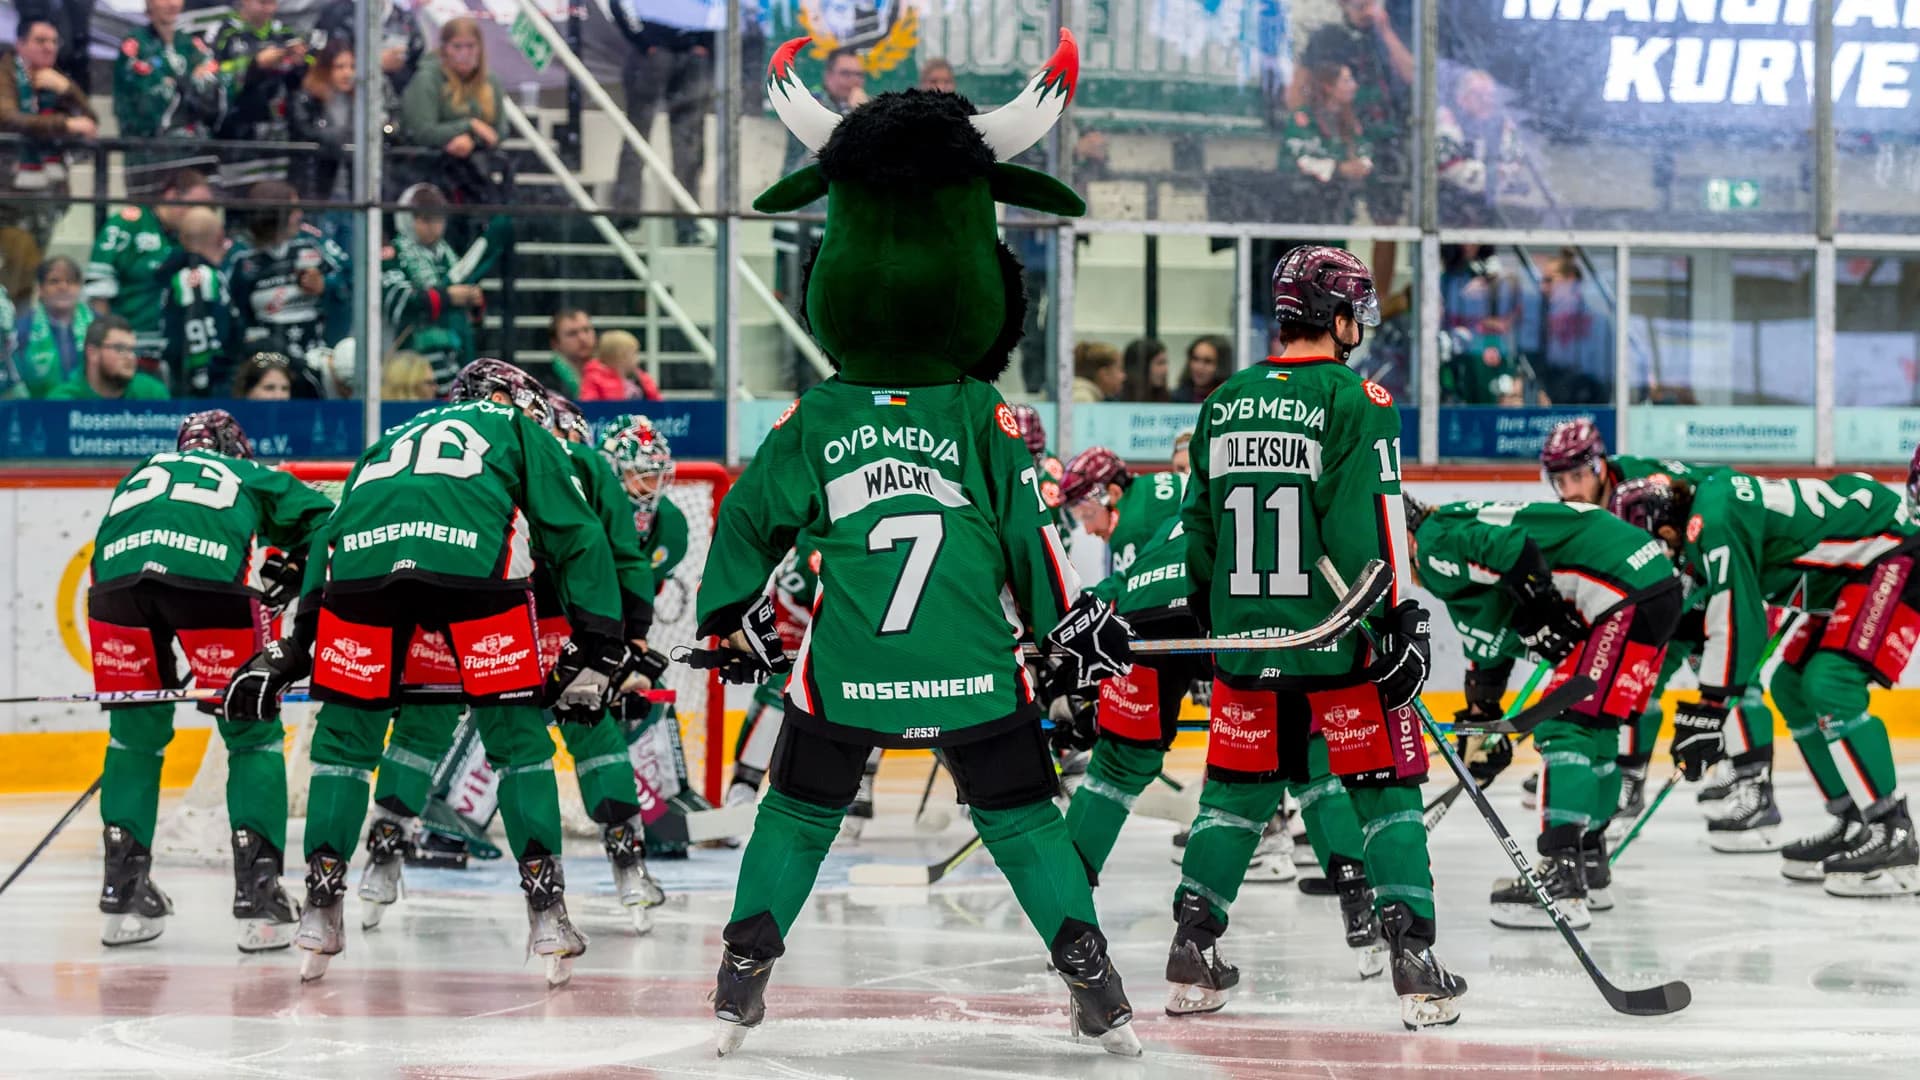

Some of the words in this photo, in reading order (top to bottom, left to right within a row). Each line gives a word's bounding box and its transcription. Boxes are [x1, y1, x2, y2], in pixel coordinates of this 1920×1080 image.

[1603, 36, 1919, 108] KURVE
[1211, 397, 1254, 426] OVB
[1258, 396, 1326, 431] MEDIA
[824, 425, 878, 464] OVB
[882, 426, 960, 466] MEDIA
[1227, 437, 1310, 469] OLEKSUK
[109, 452, 242, 517] 53
[864, 464, 934, 498] WACKI
[1020, 466, 1047, 513] 7
[103, 529, 228, 561] ROSENHEIM
[343, 521, 478, 553] ROSENHEIM
[1222, 484, 1311, 597] 11
[866, 510, 946, 637] 7
[320, 647, 386, 677] Flötzinger
[464, 648, 530, 671] Flötzinger
[842, 674, 994, 700] ROSENHEIM
[1212, 717, 1271, 742] Flötzinger
[1502, 836, 1570, 922] BAUER
